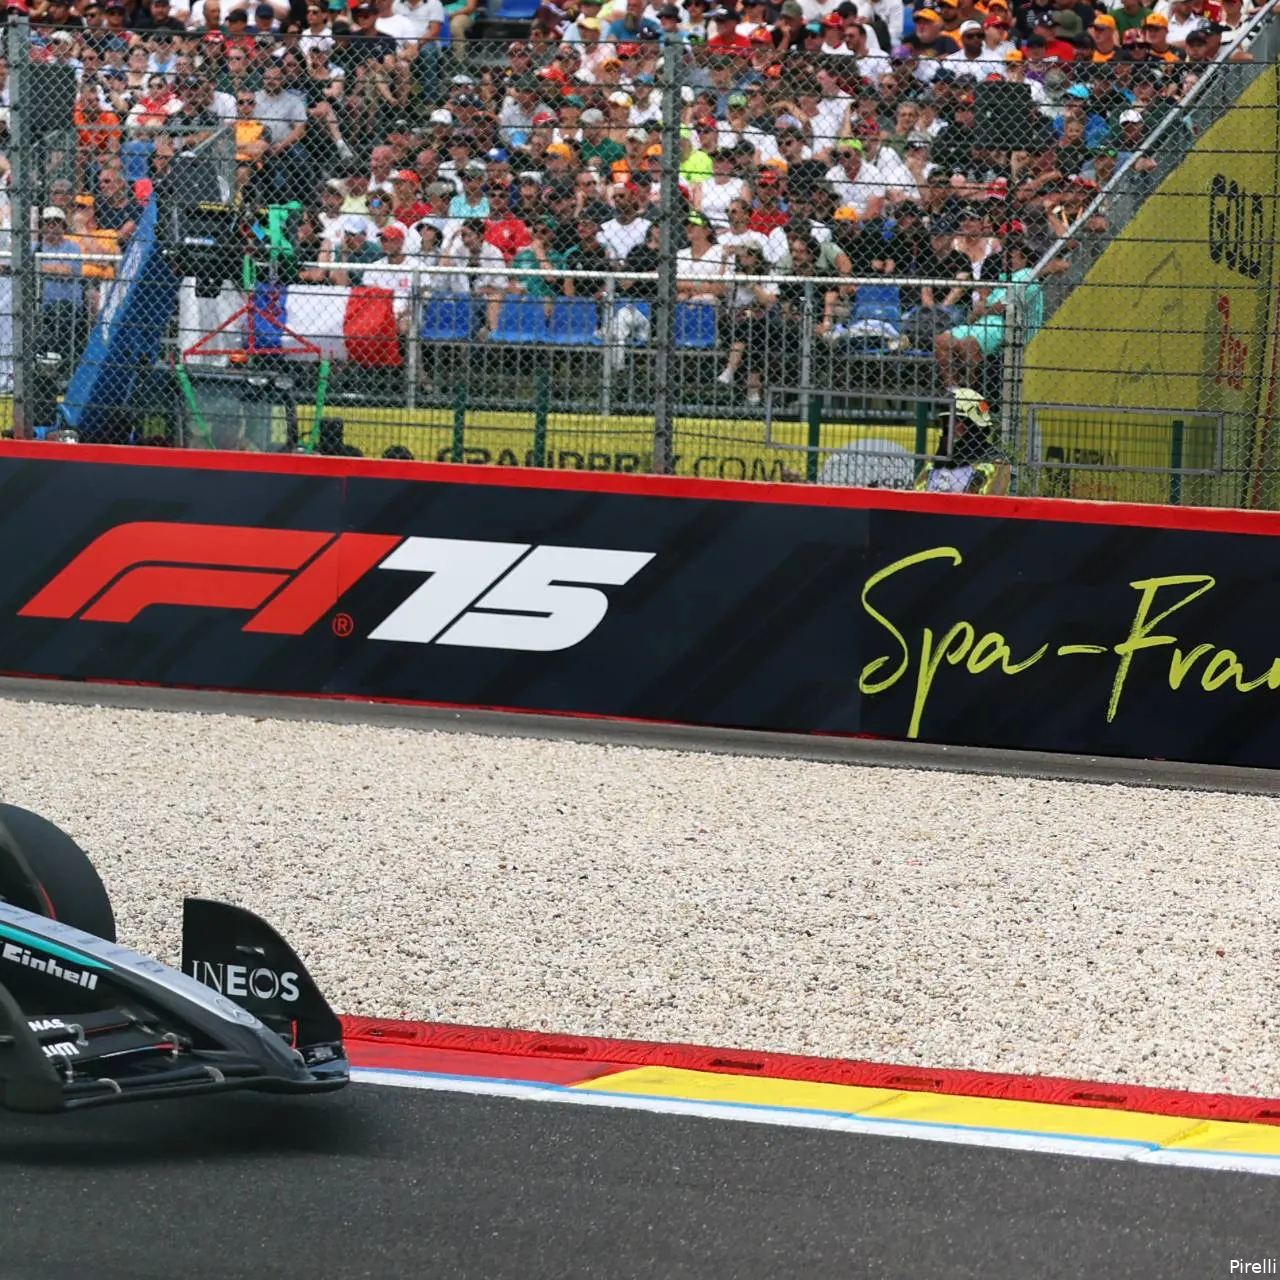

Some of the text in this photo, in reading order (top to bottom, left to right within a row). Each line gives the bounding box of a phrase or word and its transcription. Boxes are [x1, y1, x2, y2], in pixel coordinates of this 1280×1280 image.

[16, 520, 657, 653] F1 75
[859, 546, 1280, 739] Spa-Fra
[2, 942, 99, 991] Einhell
[191, 959, 301, 1002] INEOS
